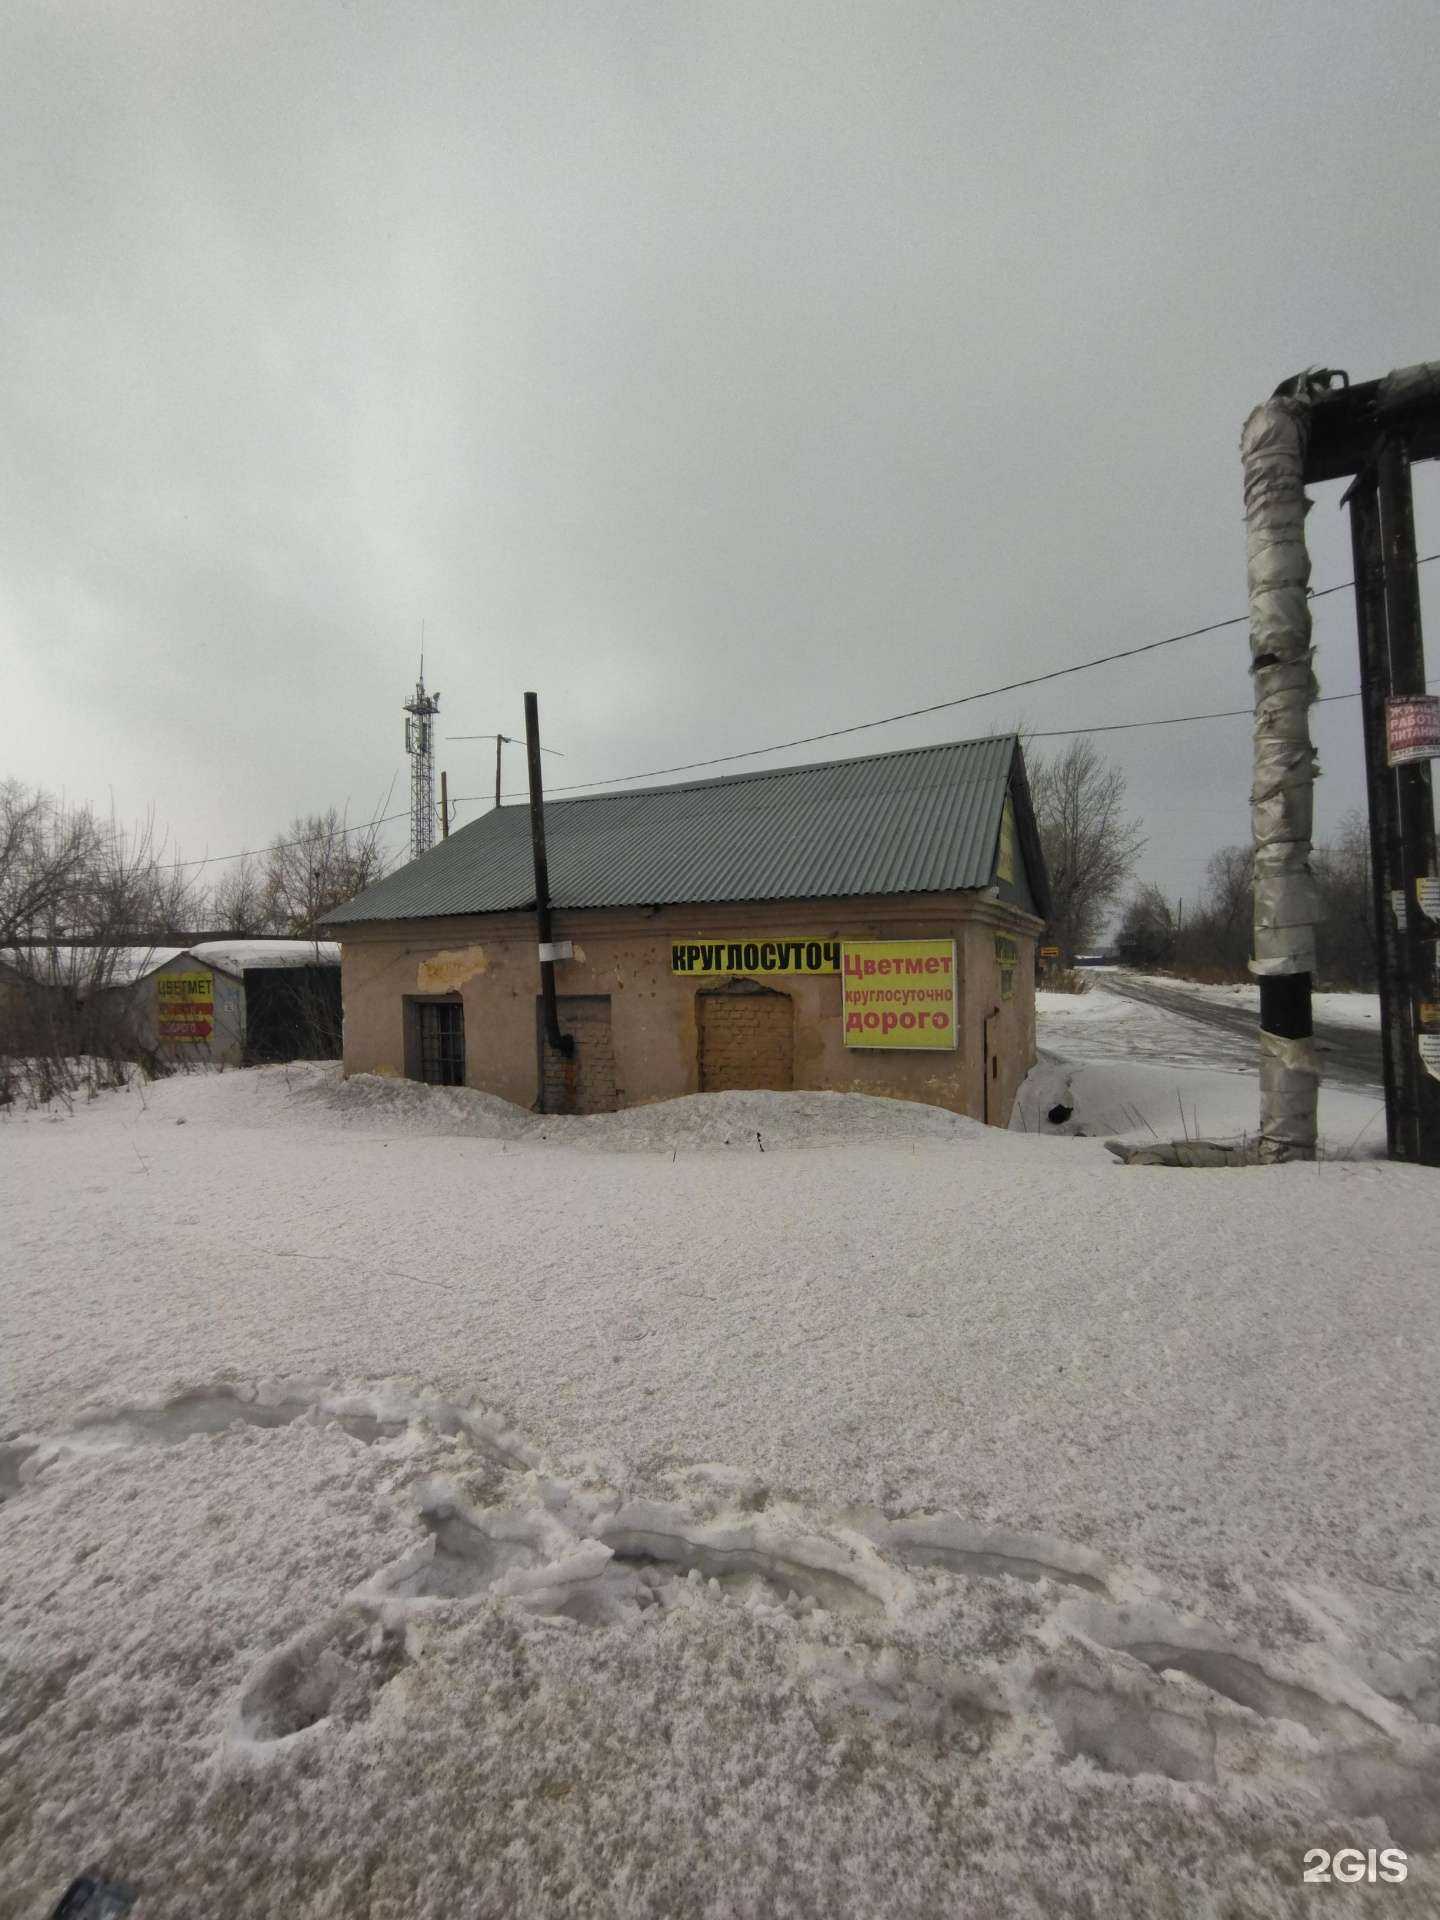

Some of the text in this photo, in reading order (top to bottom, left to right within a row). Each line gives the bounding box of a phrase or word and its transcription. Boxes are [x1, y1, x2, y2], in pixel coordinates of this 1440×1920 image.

[1390, 714, 1440, 730] РАБОТА
[672, 942, 840, 971] КРУГЛОСУТОЧ
[844, 954, 953, 980] Цветмет
[845, 989, 953, 1006] круглосуточно
[846, 1011, 950, 1035] дорого
